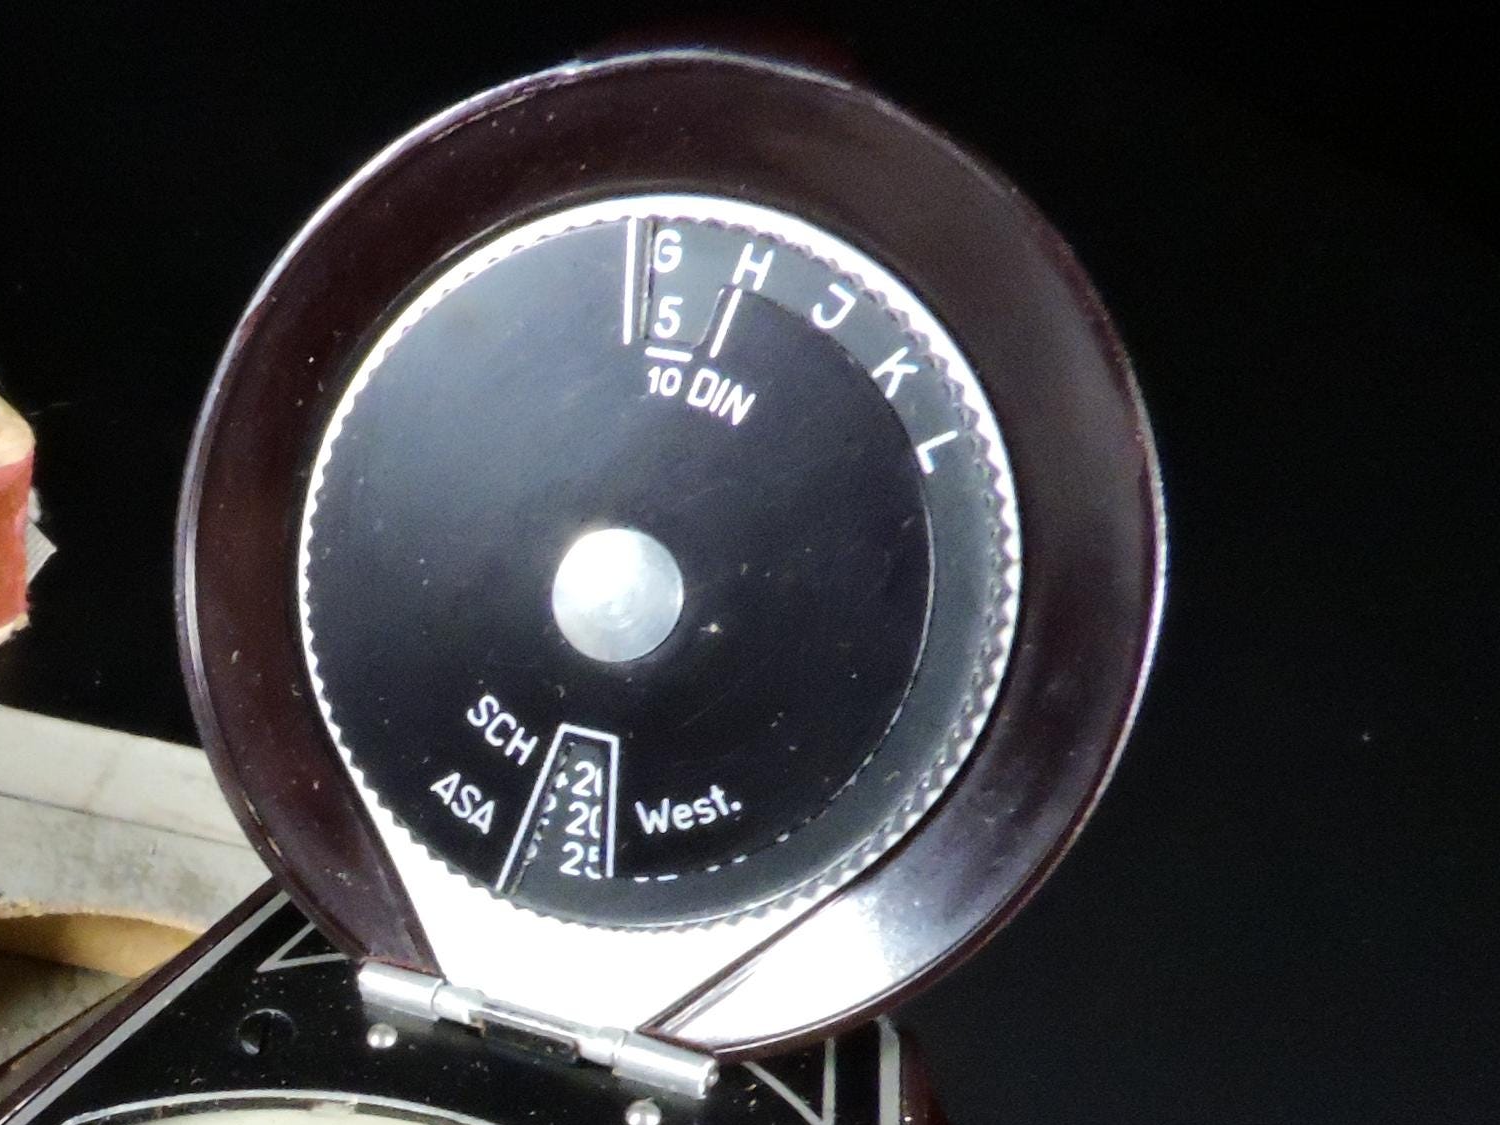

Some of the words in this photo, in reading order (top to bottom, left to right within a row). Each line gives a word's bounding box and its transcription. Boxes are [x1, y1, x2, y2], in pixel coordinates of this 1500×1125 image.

[653, 296, 683, 339] 5
[654, 229, 683, 273] G
[731, 242, 774, 291] H
[812, 283, 856, 330] J
[871, 346, 919, 399] K
[916, 430, 959, 475] L
[646, 365, 682, 397] 10
[685, 367, 757, 427] DIN
[466, 694, 539, 766] SCH
[429, 772, 495, 835] ASA
[634, 784, 742, 835] West.
